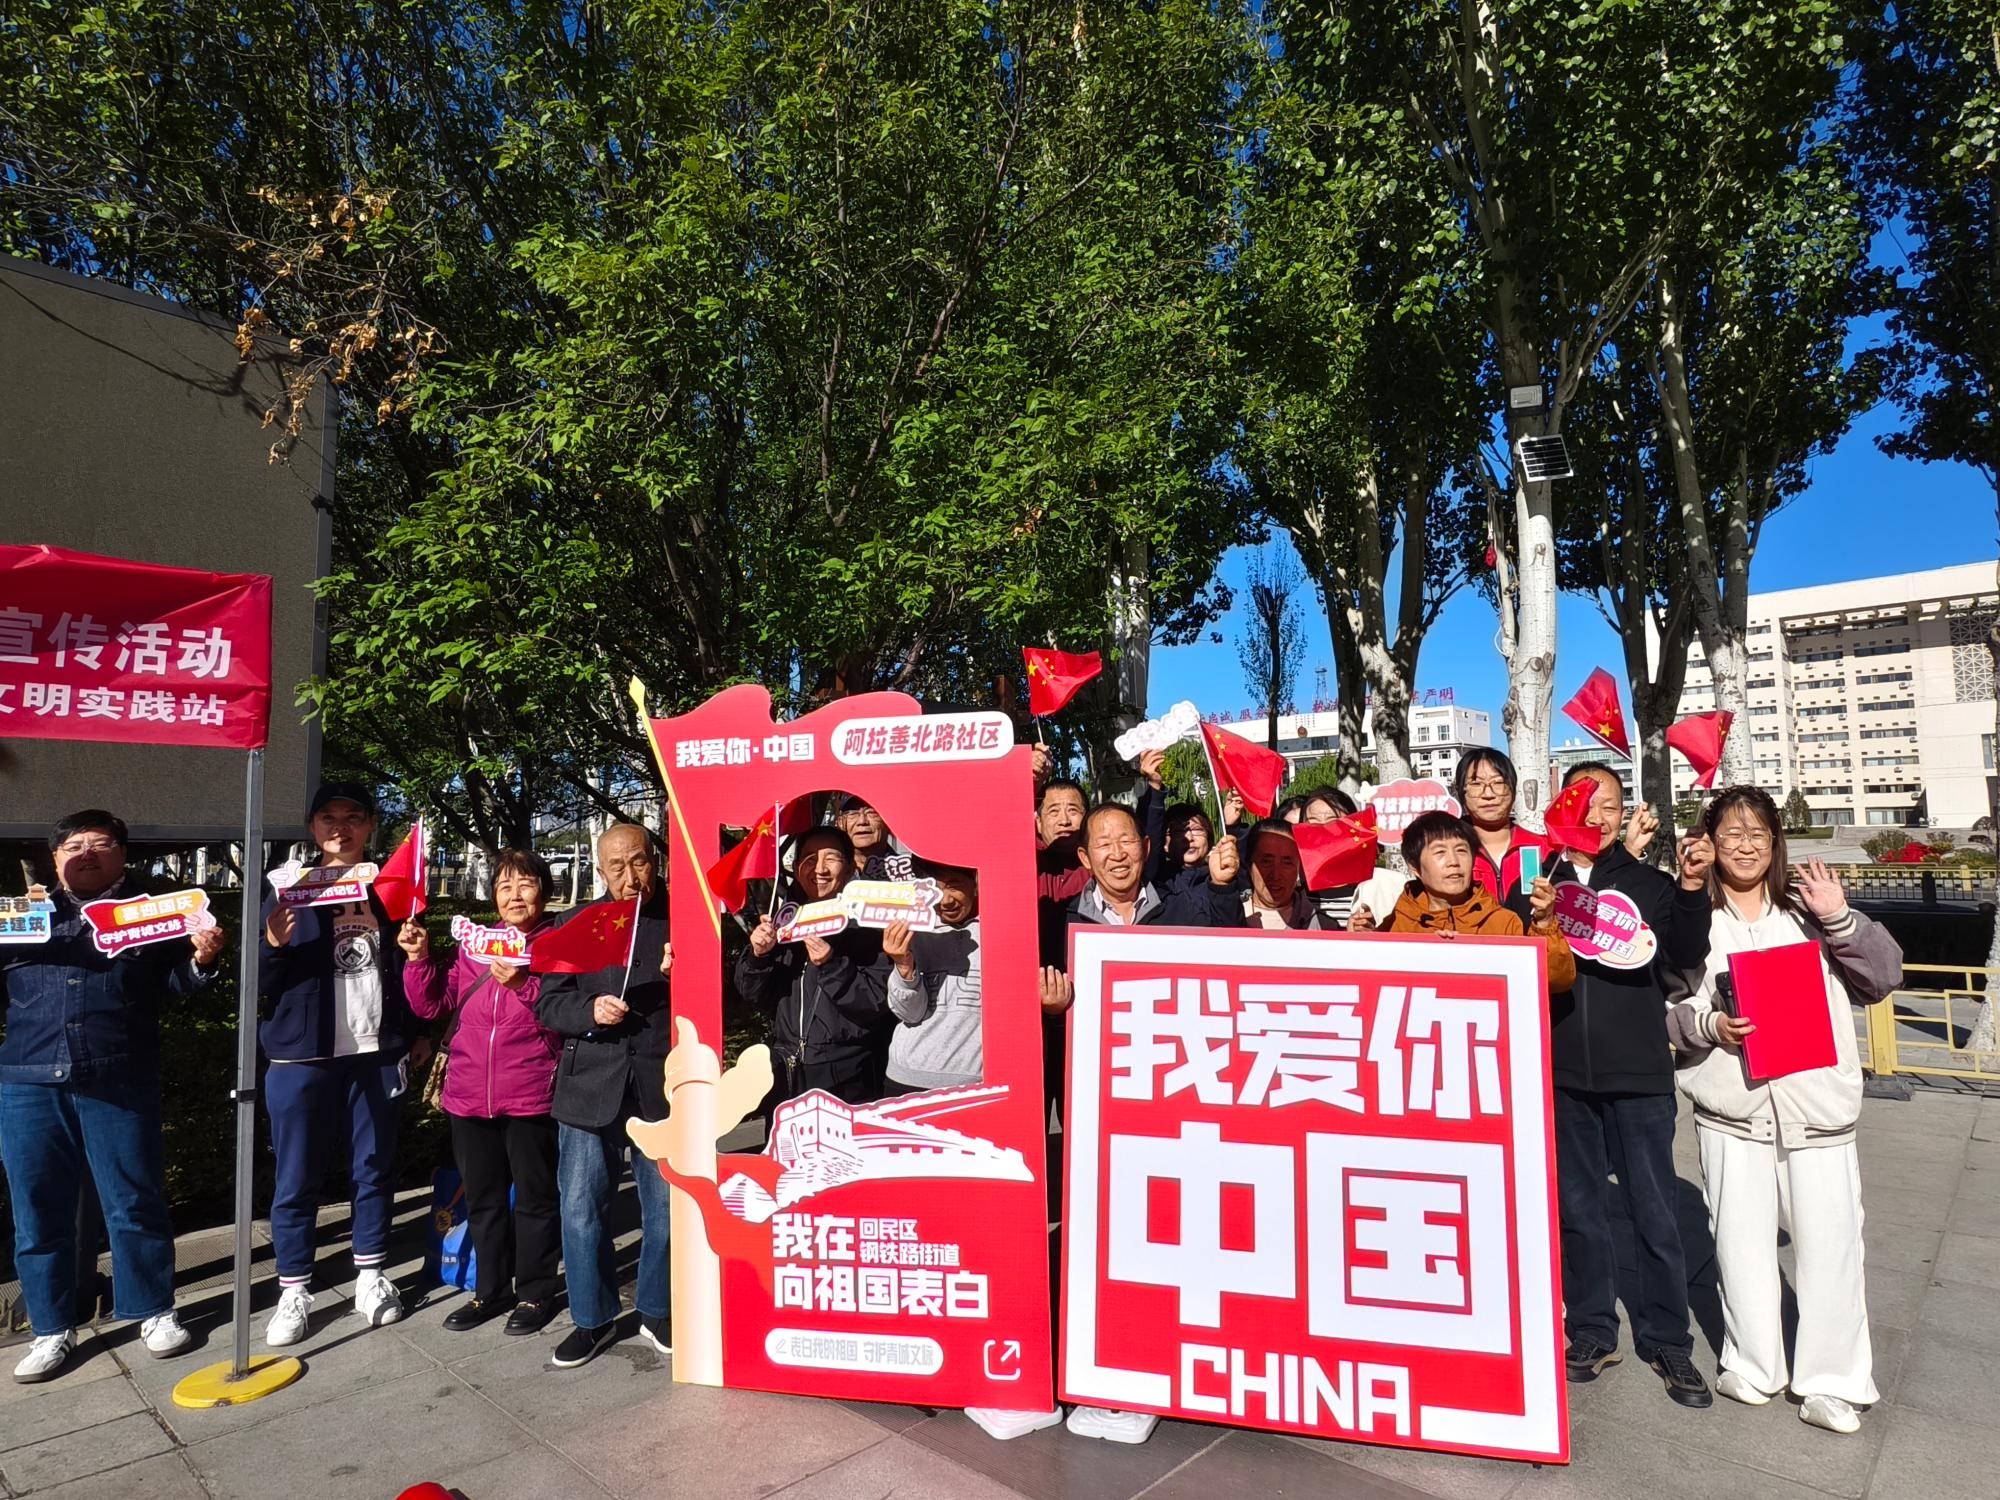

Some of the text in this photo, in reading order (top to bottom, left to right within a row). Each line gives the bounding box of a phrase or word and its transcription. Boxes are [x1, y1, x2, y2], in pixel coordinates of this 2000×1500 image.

[0, 606, 232, 679] 宣传活动
[843, 721, 1003, 757] 阿拉善北路社区
[121, 895, 194, 921] 喜迎国庆
[1573, 893, 1638, 931] 我爱你
[98, 919, 182, 944] 守护青城文脉
[1555, 911, 1637, 960] 我的祖国
[1111, 978, 1504, 1120] 我爱你
[772, 1212, 856, 1261] 我在
[860, 1217, 918, 1241] 回民区
[1108, 1121, 1512, 1355] 中国
[859, 1241, 960, 1267] 钢铁路街道
[774, 1263, 989, 1319] 向祖国表白
[790, 1336, 934, 1367] 表白我的祖国 守护青城文脉
[1180, 1342, 1411, 1437] CHINA
